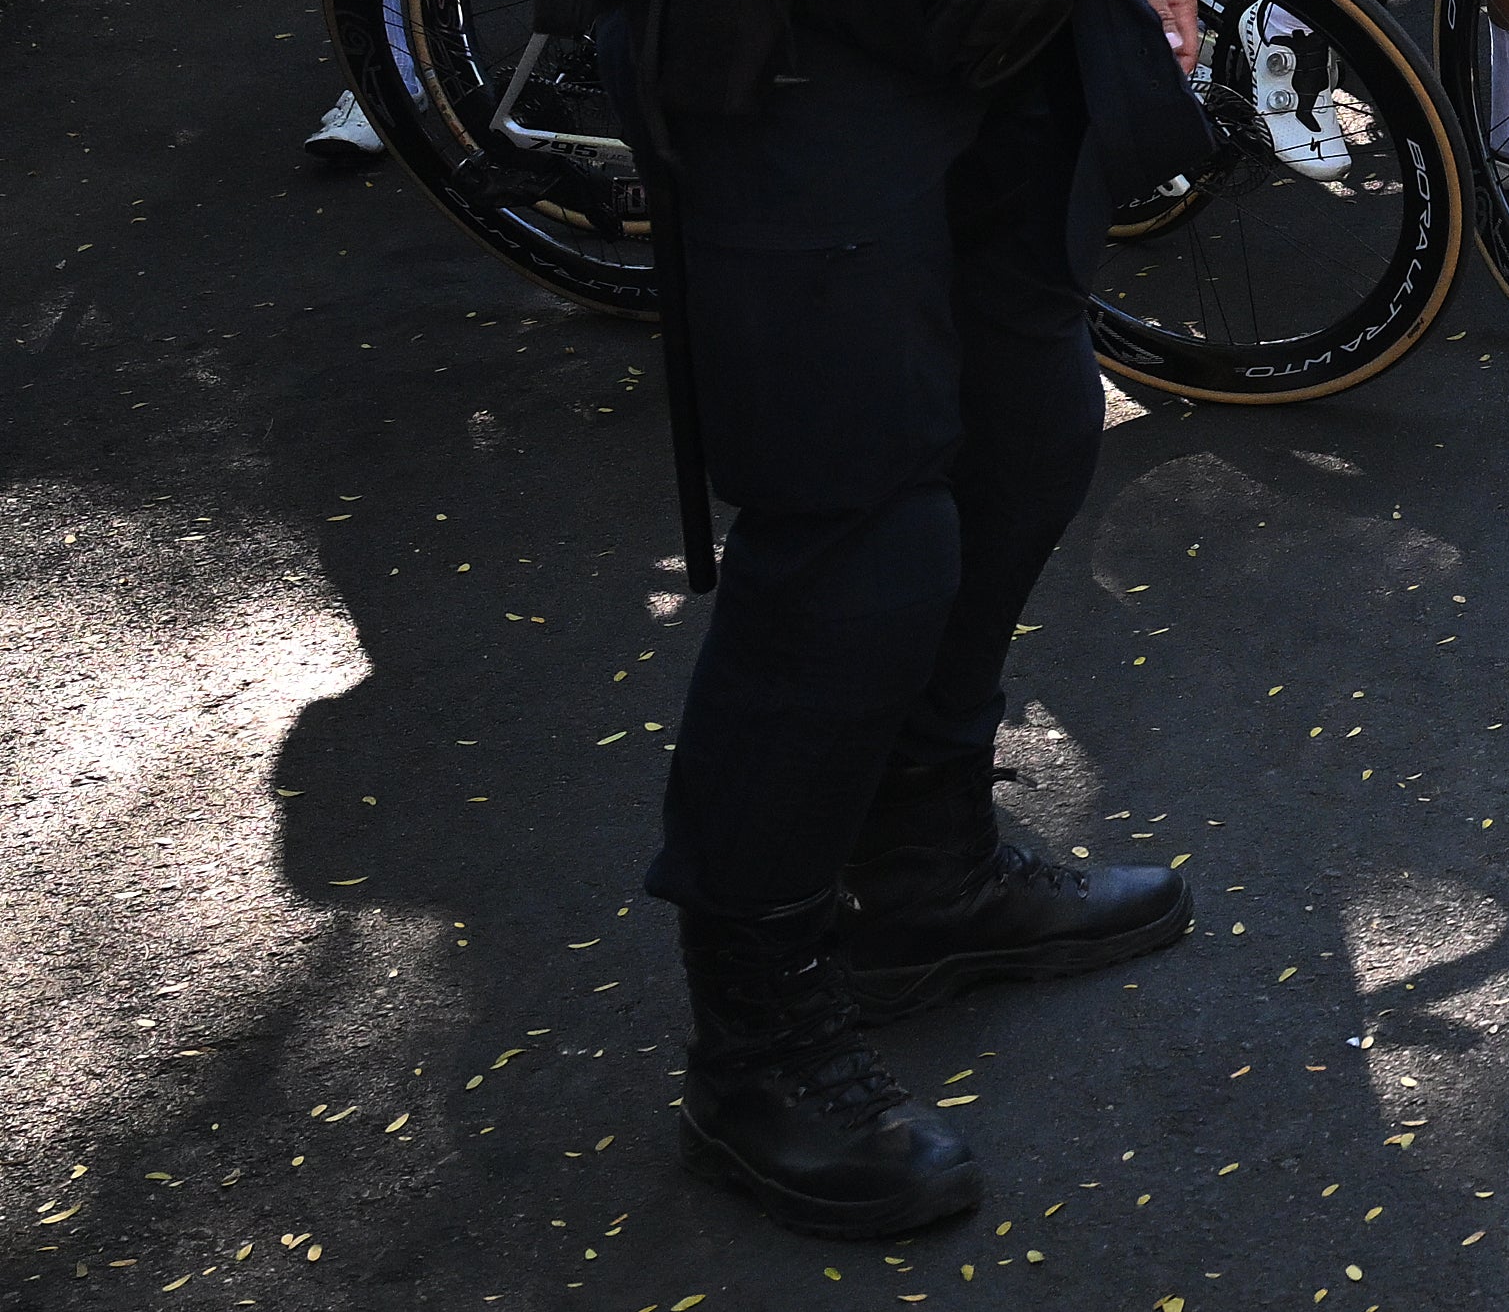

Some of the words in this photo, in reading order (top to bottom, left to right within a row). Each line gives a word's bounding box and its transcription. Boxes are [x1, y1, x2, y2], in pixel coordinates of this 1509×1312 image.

[529, 138, 599, 159] 795
[1406, 137, 1433, 252] BORA
[1338, 257, 1423, 355] ULTRA
[1244, 349, 1333, 379] WTO
